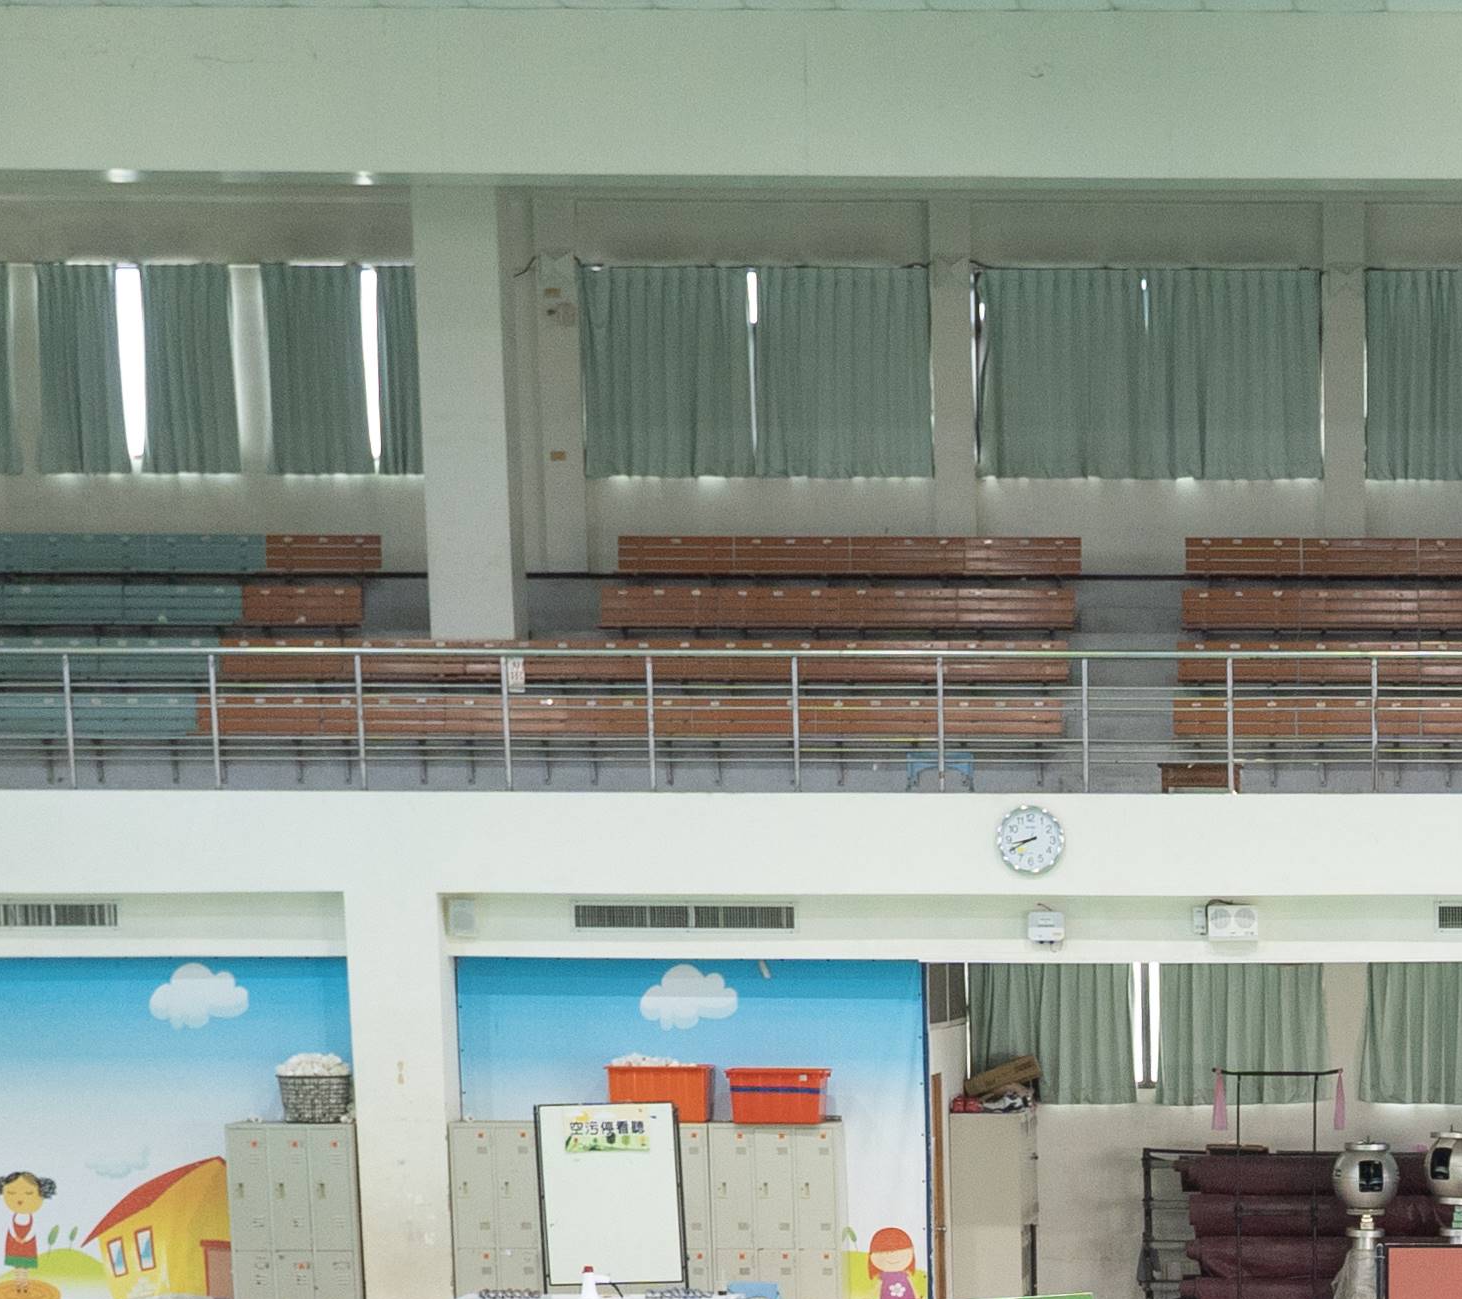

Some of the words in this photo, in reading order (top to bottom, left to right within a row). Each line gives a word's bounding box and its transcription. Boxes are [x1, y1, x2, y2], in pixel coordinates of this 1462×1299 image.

[569, 1119, 645, 1137] 空污停看聽
